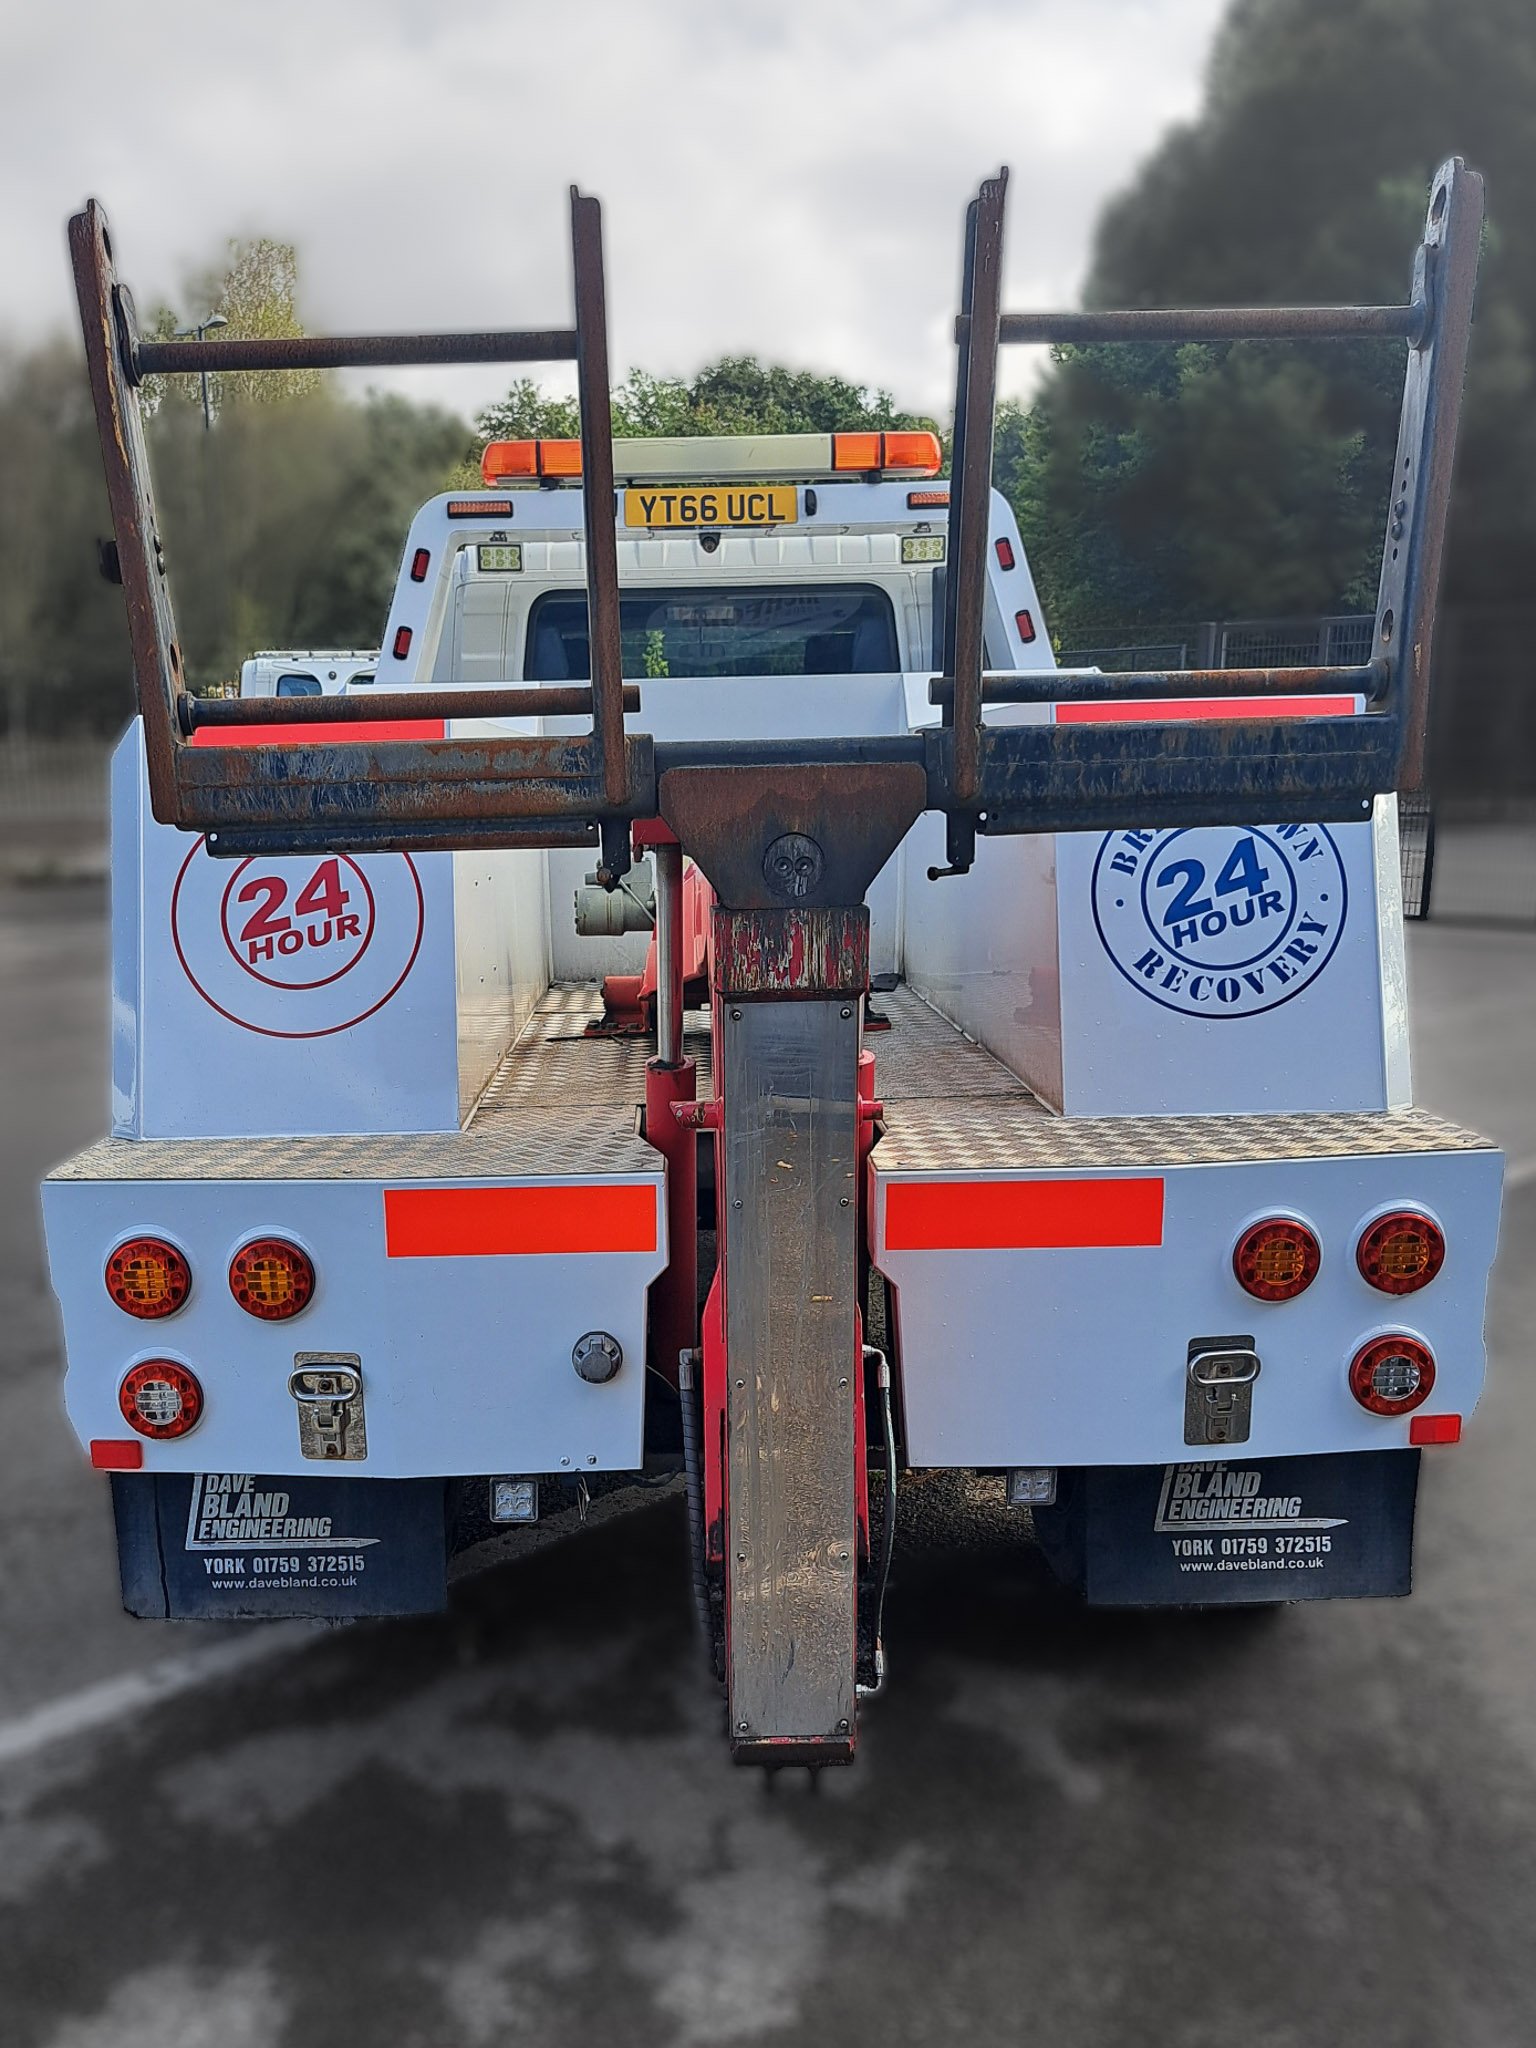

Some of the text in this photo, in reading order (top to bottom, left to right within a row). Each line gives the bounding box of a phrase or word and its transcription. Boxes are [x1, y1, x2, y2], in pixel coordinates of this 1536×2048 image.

[639, 493, 786, 523] YT66 UCL
[1156, 836, 1270, 926] 24
[237, 858, 350, 942] 24
[1172, 890, 1286, 948] HOUR
[248, 914, 362, 964] HOUR
[1132, 911, 1328, 1003] RECOVERY
[205, 1474, 256, 1493] DAVE
[1173, 1471, 1262, 1499] BLAND
[202, 1492, 290, 1519] BLAND
[1168, 1496, 1302, 1521] ENGINEERING
[198, 1517, 332, 1540] ENGINEERING
[1172, 1535, 1332, 1556] YORK 01759 372515
[203, 1554, 365, 1574] YORK 01759 372515
[1180, 1557, 1324, 1572] www.davebland.co.uk
[211, 1575, 358, 1590] www.davebland.co.uk
